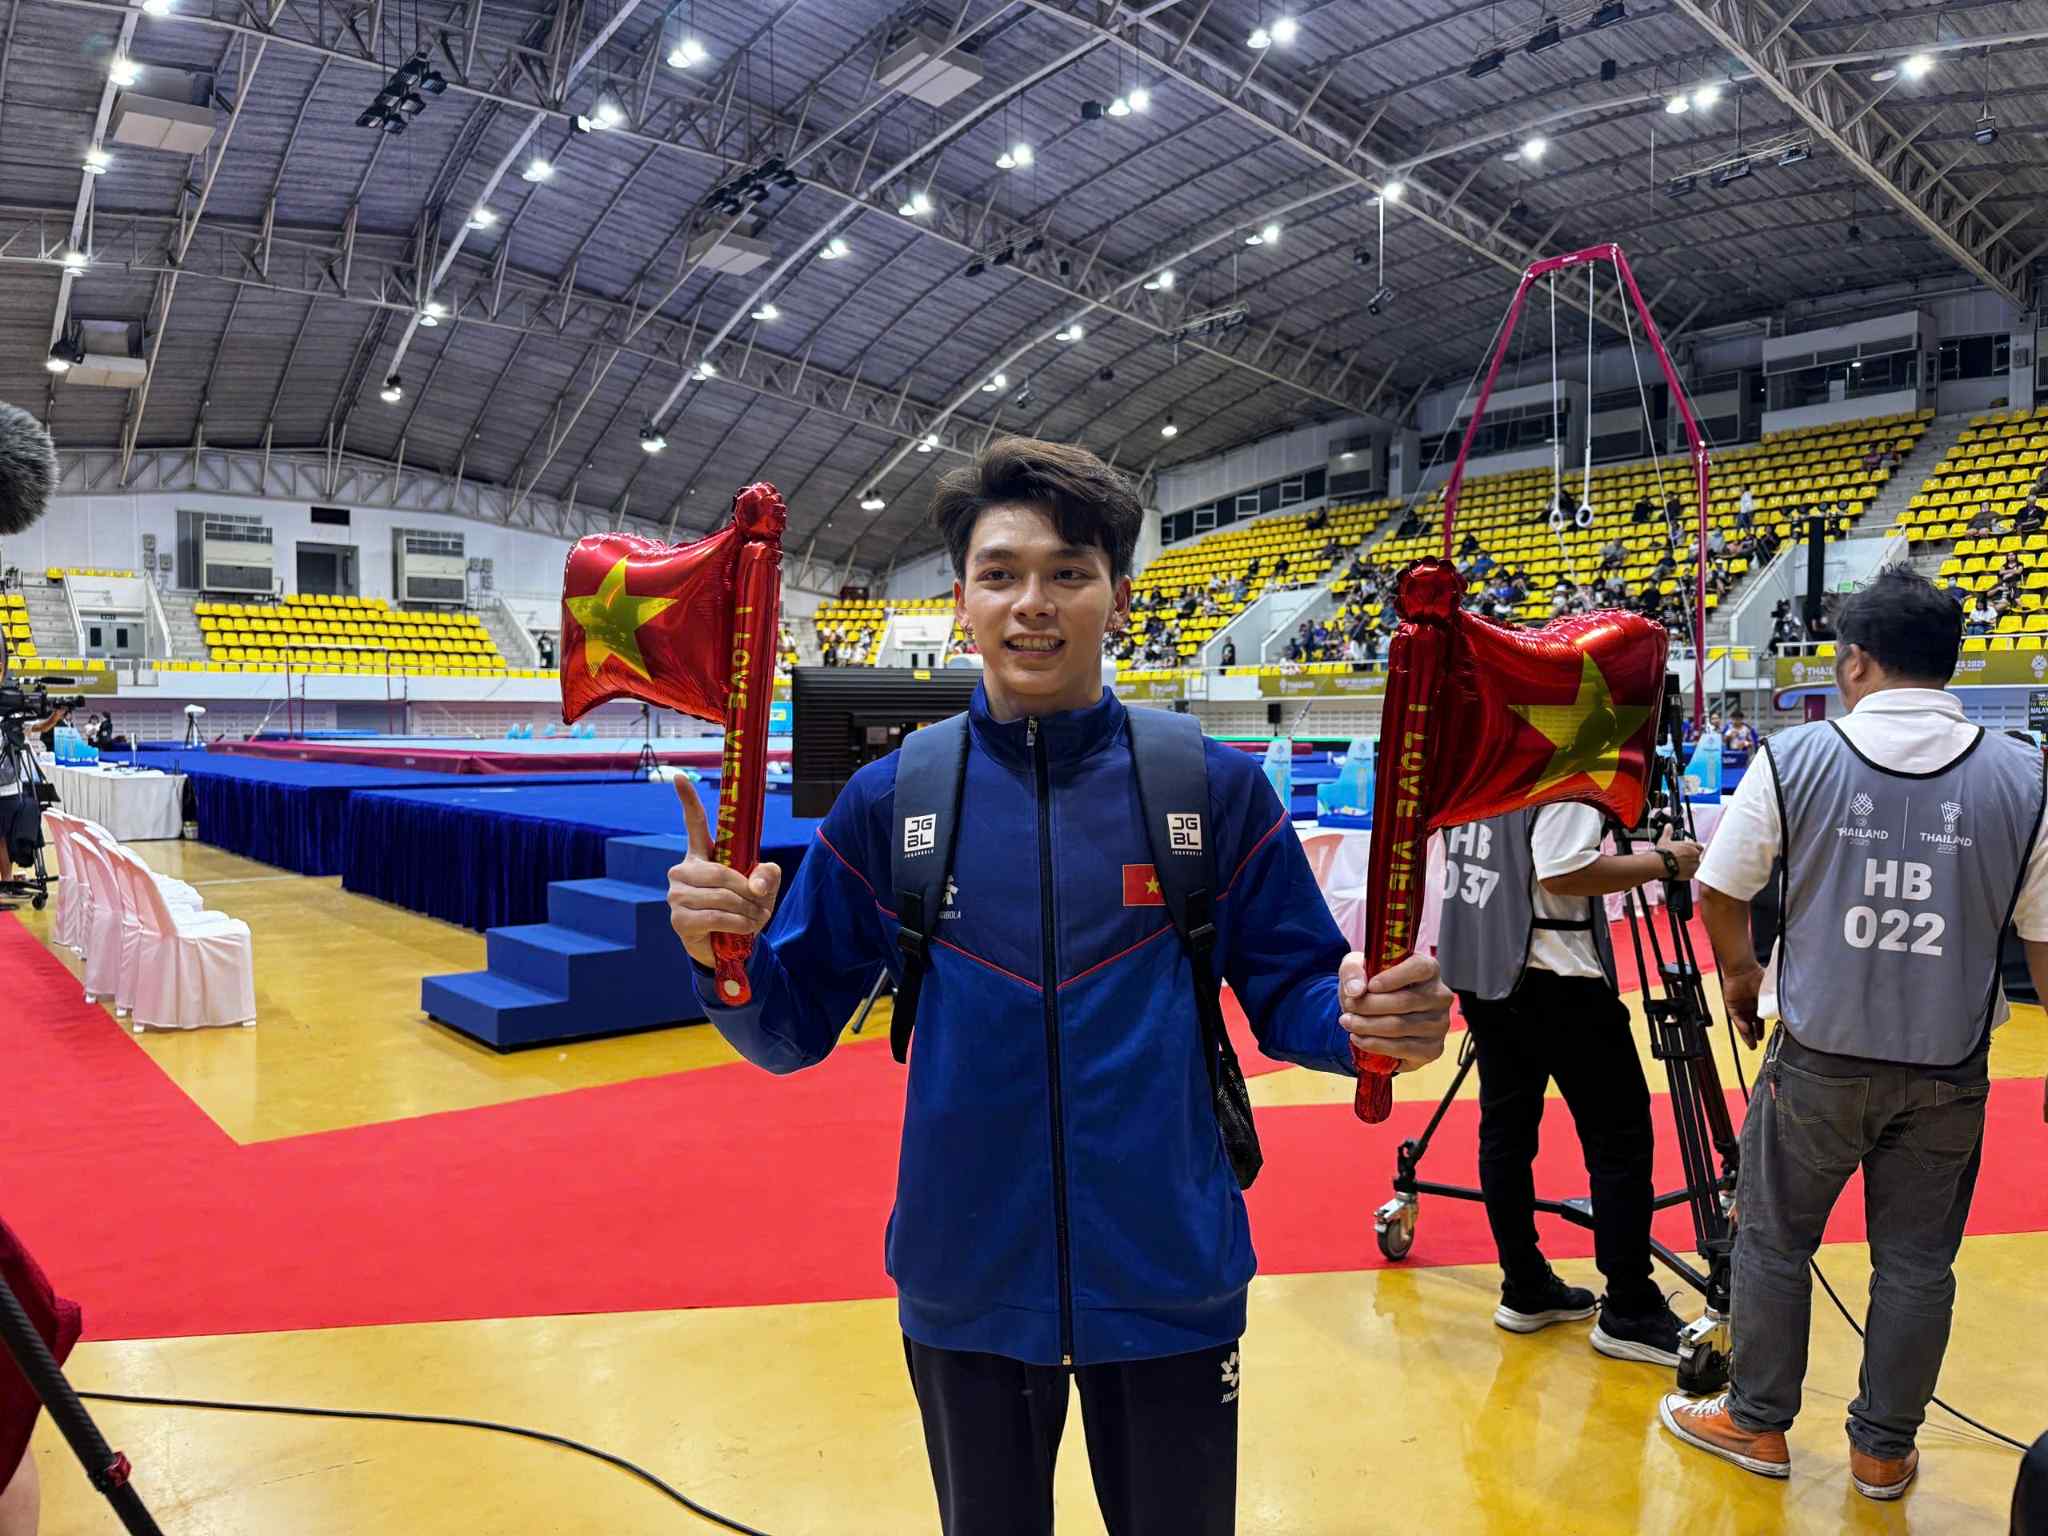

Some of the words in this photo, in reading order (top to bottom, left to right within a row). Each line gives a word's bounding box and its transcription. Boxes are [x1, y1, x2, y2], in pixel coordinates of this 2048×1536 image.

[728, 632, 751, 710] LOVE
[1396, 731, 1425, 817] LOVE
[908, 818, 932, 833] JG
[1172, 817, 1198, 830] JG
[1836, 826, 1889, 840] THAILAND
[908, 833, 932, 849] BL
[1173, 832, 1199, 845] BL
[1449, 822, 1492, 860] HB
[1920, 831, 1973, 848] THAILAND
[1864, 858, 1933, 901] HB
[1381, 840, 1415, 970] VIETNA
[1844, 906, 1946, 957] 022
